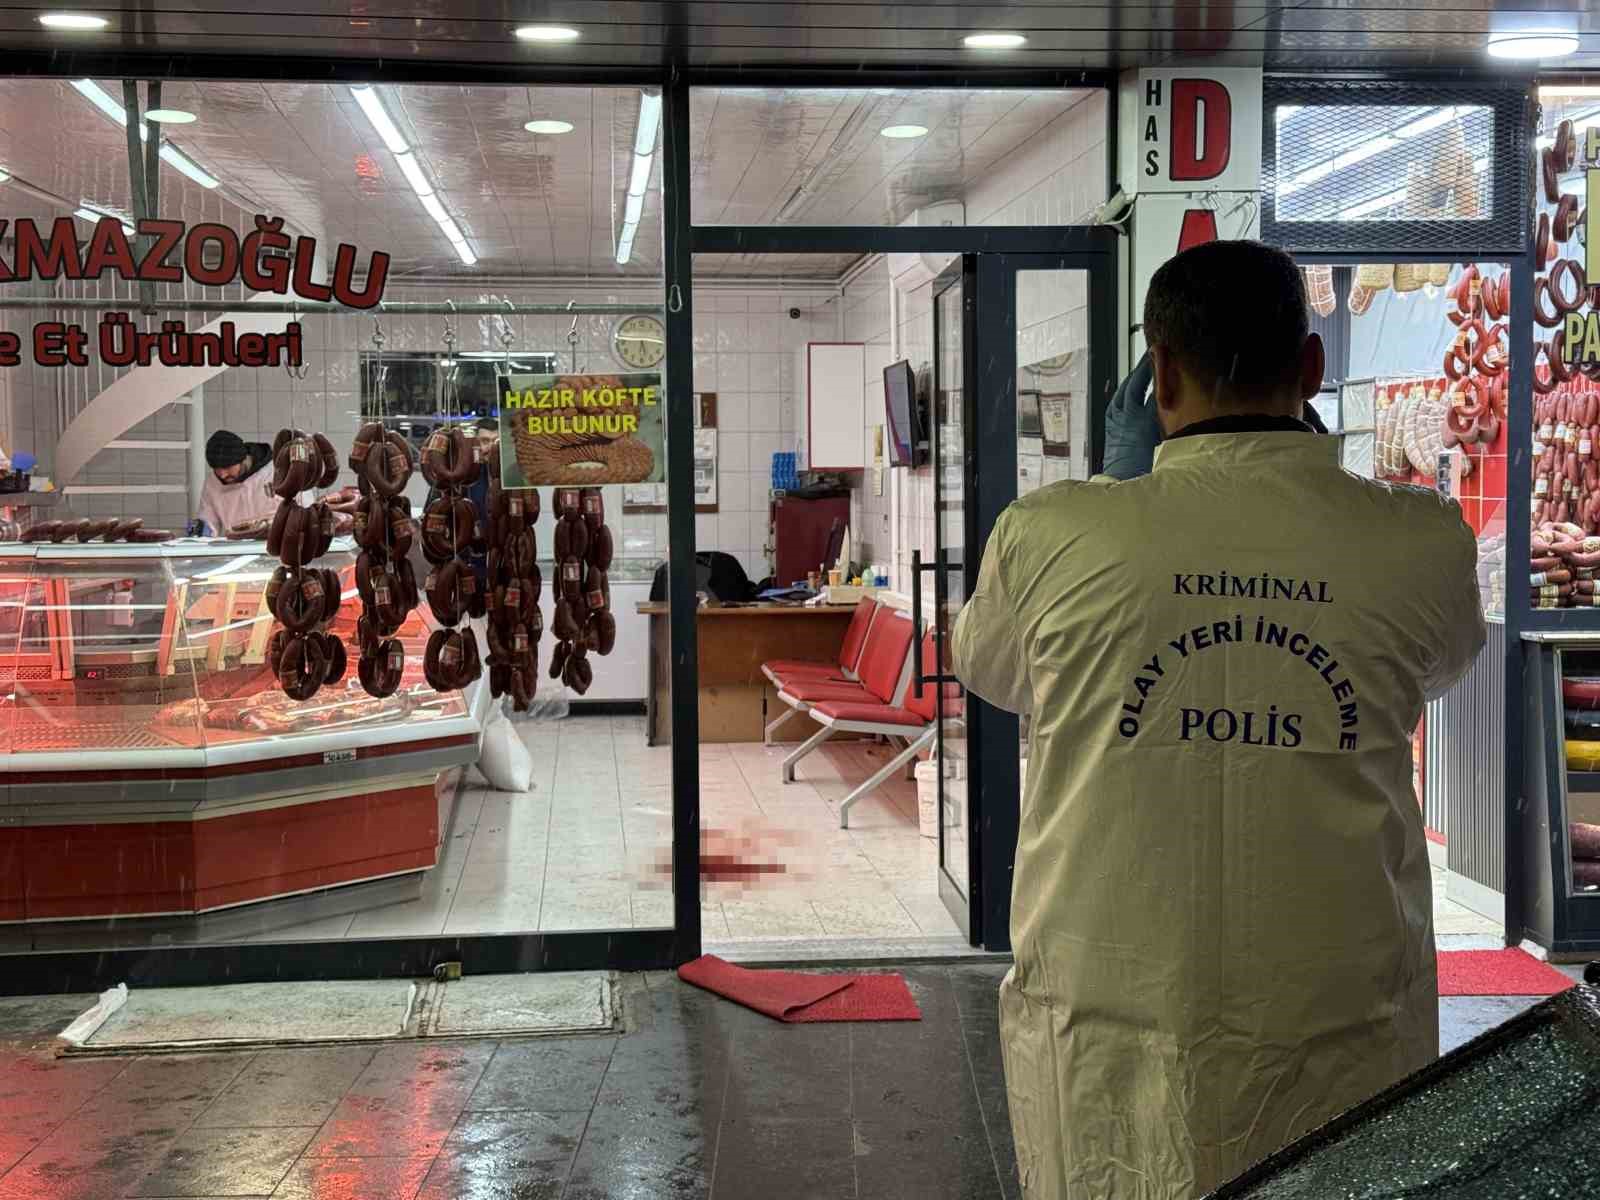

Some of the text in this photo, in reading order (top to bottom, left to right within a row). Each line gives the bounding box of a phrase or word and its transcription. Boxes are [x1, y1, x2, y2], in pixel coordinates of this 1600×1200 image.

[1145, 79, 1161, 176] HAS
[0, 214, 390, 309] MAZOĞLU
[33, 322, 89, 366] Et
[100, 312, 302, 367] Ürünleri
[505, 385, 657, 409] HAZIR KÖFTE
[528, 414, 638, 435] BULUNUR
[1173, 571, 1334, 603] KRİMİNAL
[1118, 615, 1359, 751] OLAY YERİ İNCELEME
[1178, 705, 1303, 747] POLİS
